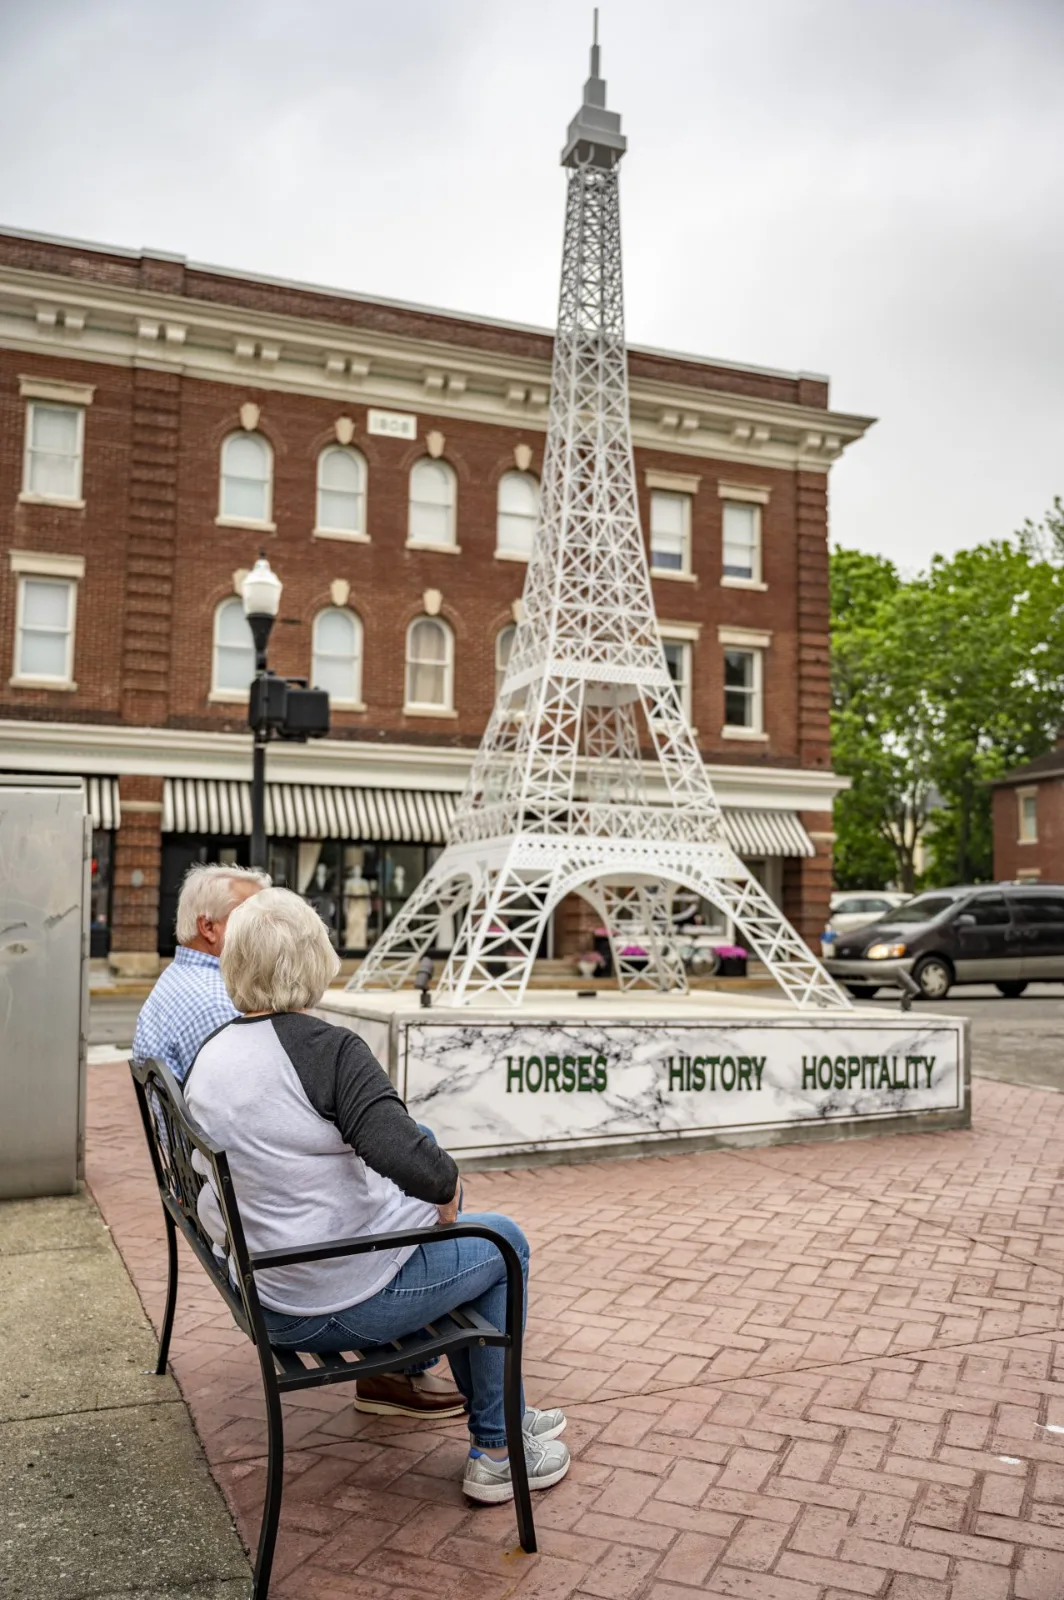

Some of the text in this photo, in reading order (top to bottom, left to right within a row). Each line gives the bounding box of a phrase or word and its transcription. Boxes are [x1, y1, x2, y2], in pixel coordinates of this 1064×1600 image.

[506, 1055, 936, 1093] HORSES HISTORY HOSPITALITY
